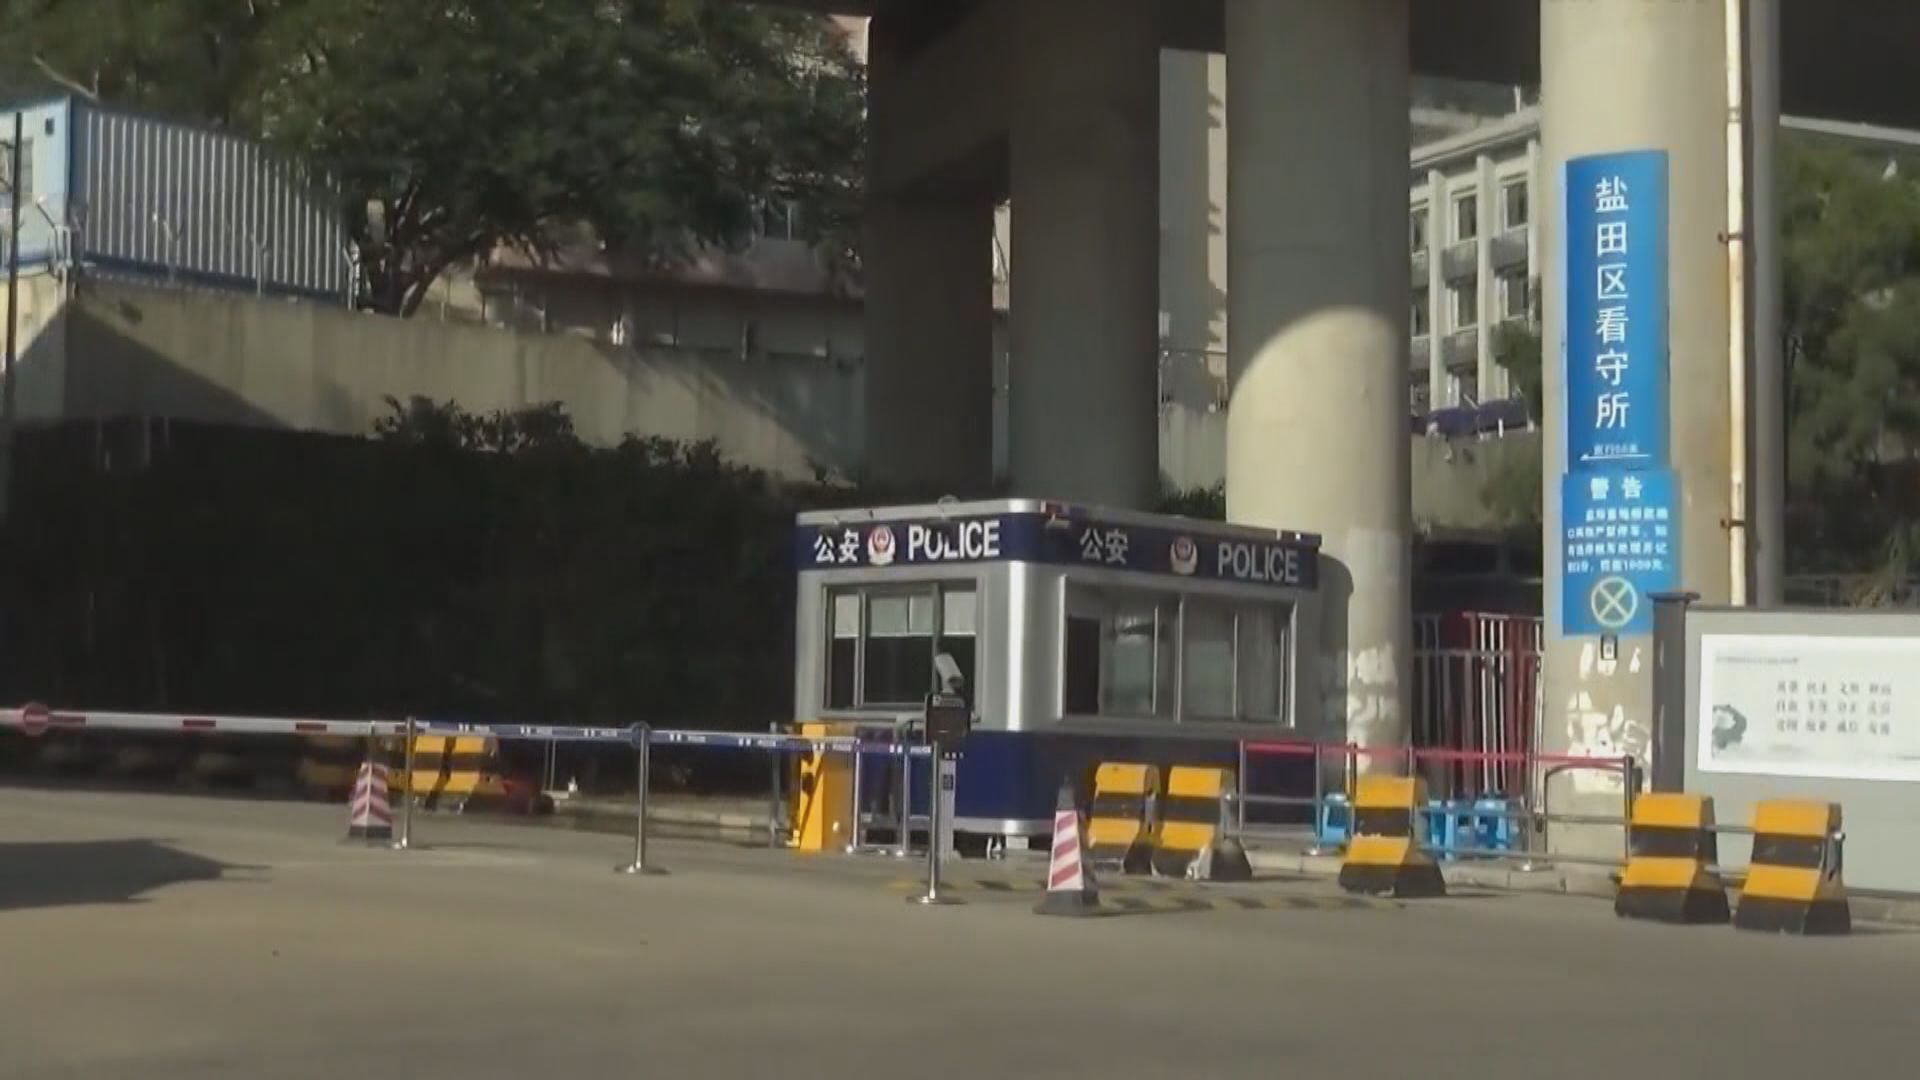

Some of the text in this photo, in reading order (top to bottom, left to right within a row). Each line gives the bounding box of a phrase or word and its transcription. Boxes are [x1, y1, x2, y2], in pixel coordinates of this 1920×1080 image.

[1595, 175, 1629, 429] 盐田区看守所
[814, 528, 860, 563] 公安
[908, 520, 1000, 561] POLICE
[1080, 527, 1129, 564] 公安
[1217, 542, 1299, 583] POLICE
